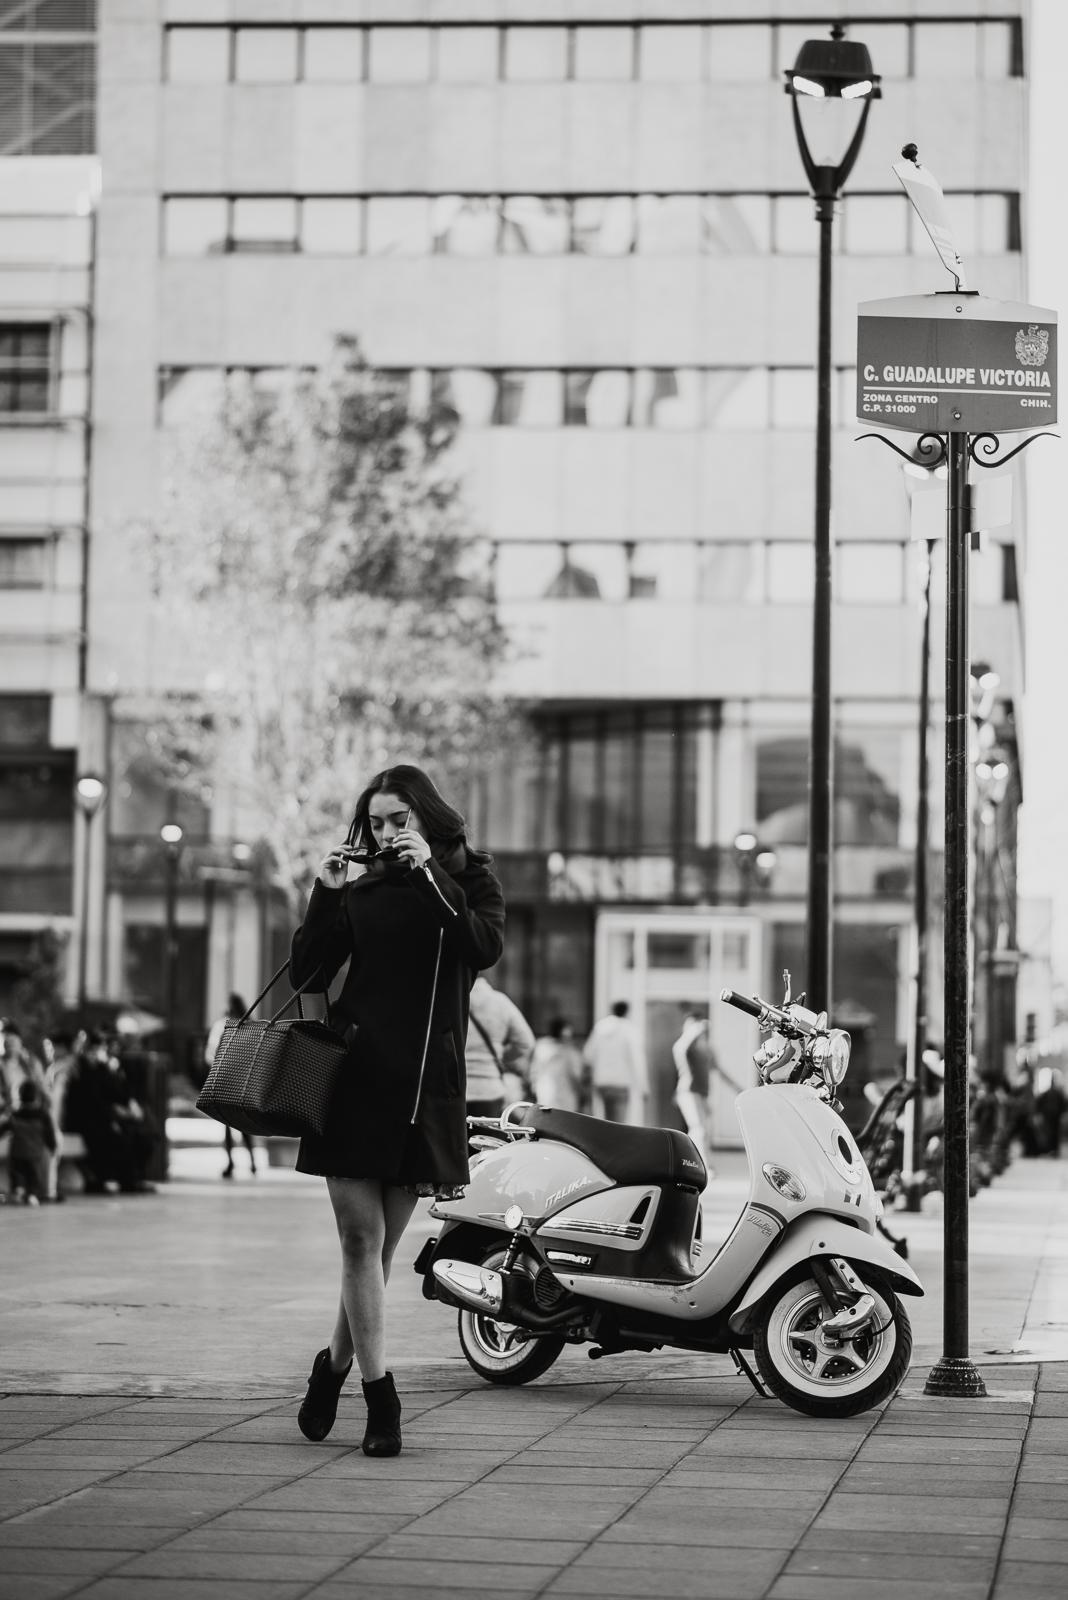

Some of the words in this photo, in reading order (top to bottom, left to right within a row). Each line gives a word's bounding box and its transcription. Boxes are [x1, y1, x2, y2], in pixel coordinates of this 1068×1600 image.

[863, 365, 879, 382] C.
[883, 365, 976, 385] GUADALUPE
[979, 368, 1051, 388] VICTORIA
[863, 394, 893, 403] ZONA
[895, 394, 938, 404] CENTRO
[1020, 399, 1051, 408] CHIH.
[863, 404, 883, 413] C.P.
[885, 404, 917, 414] 31000
[545, 1176, 588, 1209] ITALIKA
